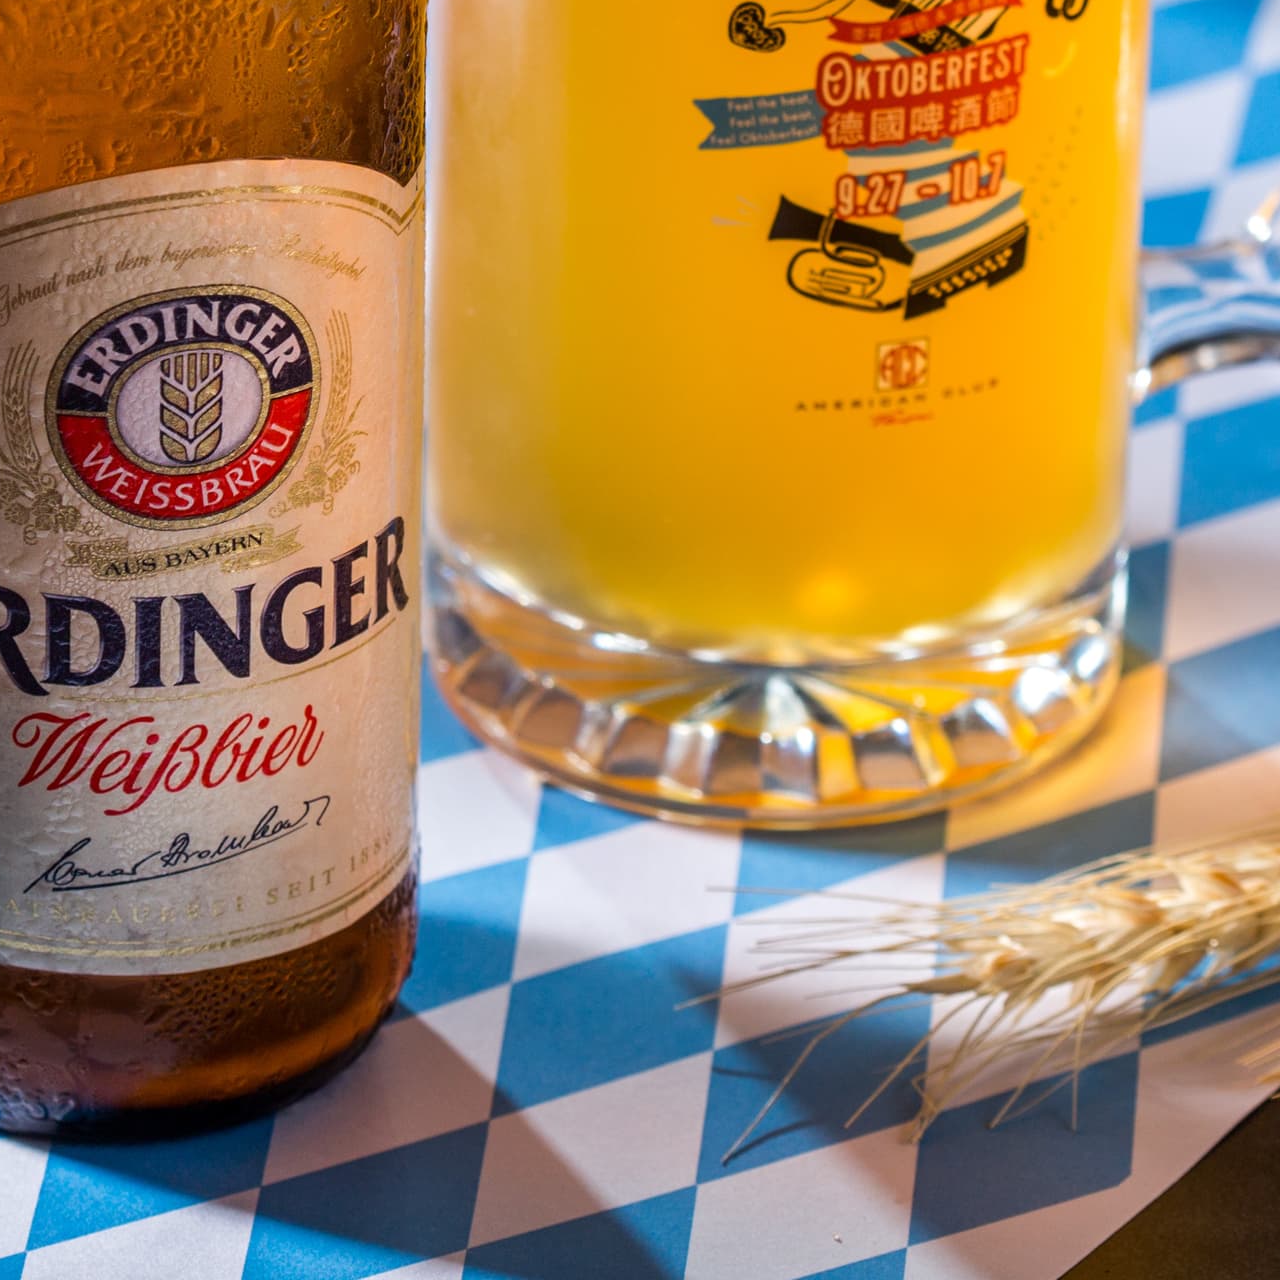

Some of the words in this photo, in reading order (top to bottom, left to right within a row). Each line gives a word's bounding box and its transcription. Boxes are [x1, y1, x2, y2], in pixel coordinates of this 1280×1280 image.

[822, 38, 1027, 108] OKTOBERFEST
[828, 85, 1019, 146] 德國啤酒節
[837, 172, 904, 218] 9.27
[951, 153, 1005, 204] 10.7
[66, 255, 106, 287] nach
[114, 249, 153, 273] dem
[69, 300, 303, 397] ERDINGER
[81, 421, 296, 512] WEISSBRÄU
[104, 555, 158, 577] AUS
[165, 531, 266, 573] BAYERN
[11, 703, 325, 817] Weißbier
[265, 866, 335, 906] SEIT
